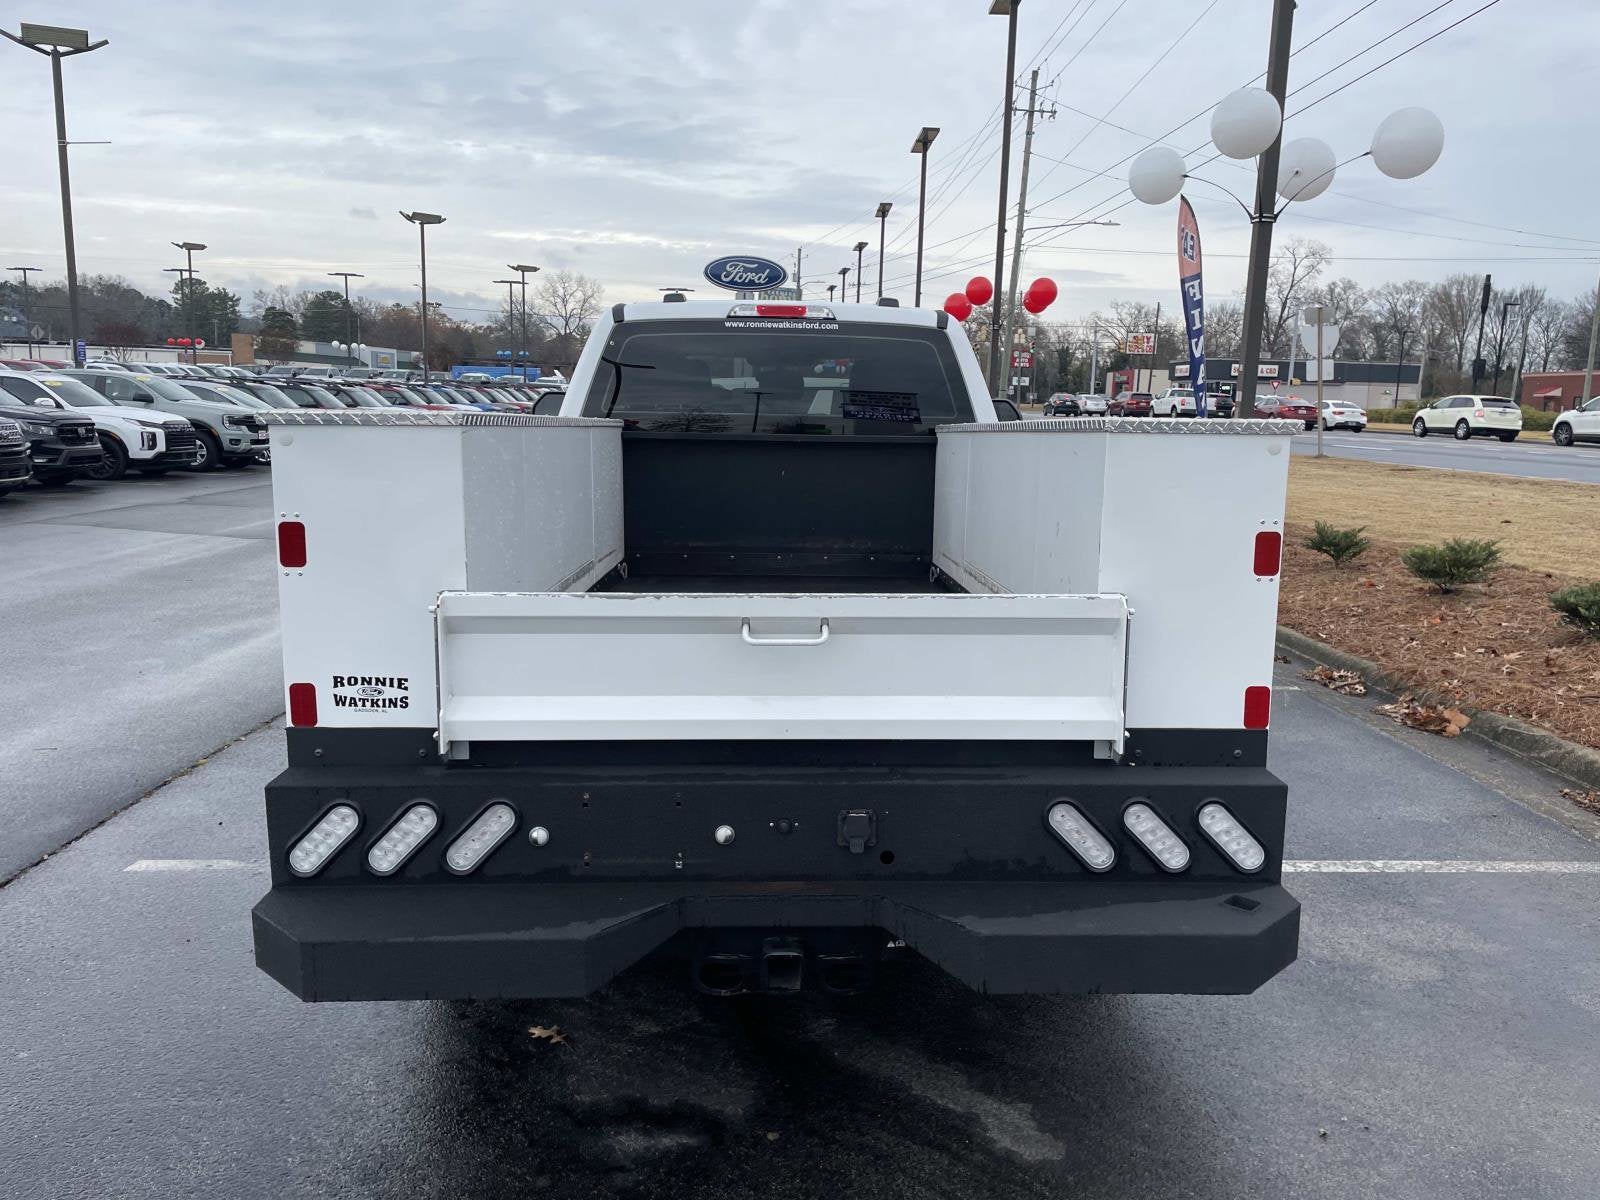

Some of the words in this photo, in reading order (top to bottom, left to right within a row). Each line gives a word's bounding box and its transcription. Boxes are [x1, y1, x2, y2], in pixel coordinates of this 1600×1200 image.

[721, 262, 770, 284] Ford
[724, 320, 839, 330] www.ronniewatkinsford.com
[332, 675, 409, 691] RONNIE
[333, 693, 409, 709] WATKINS
